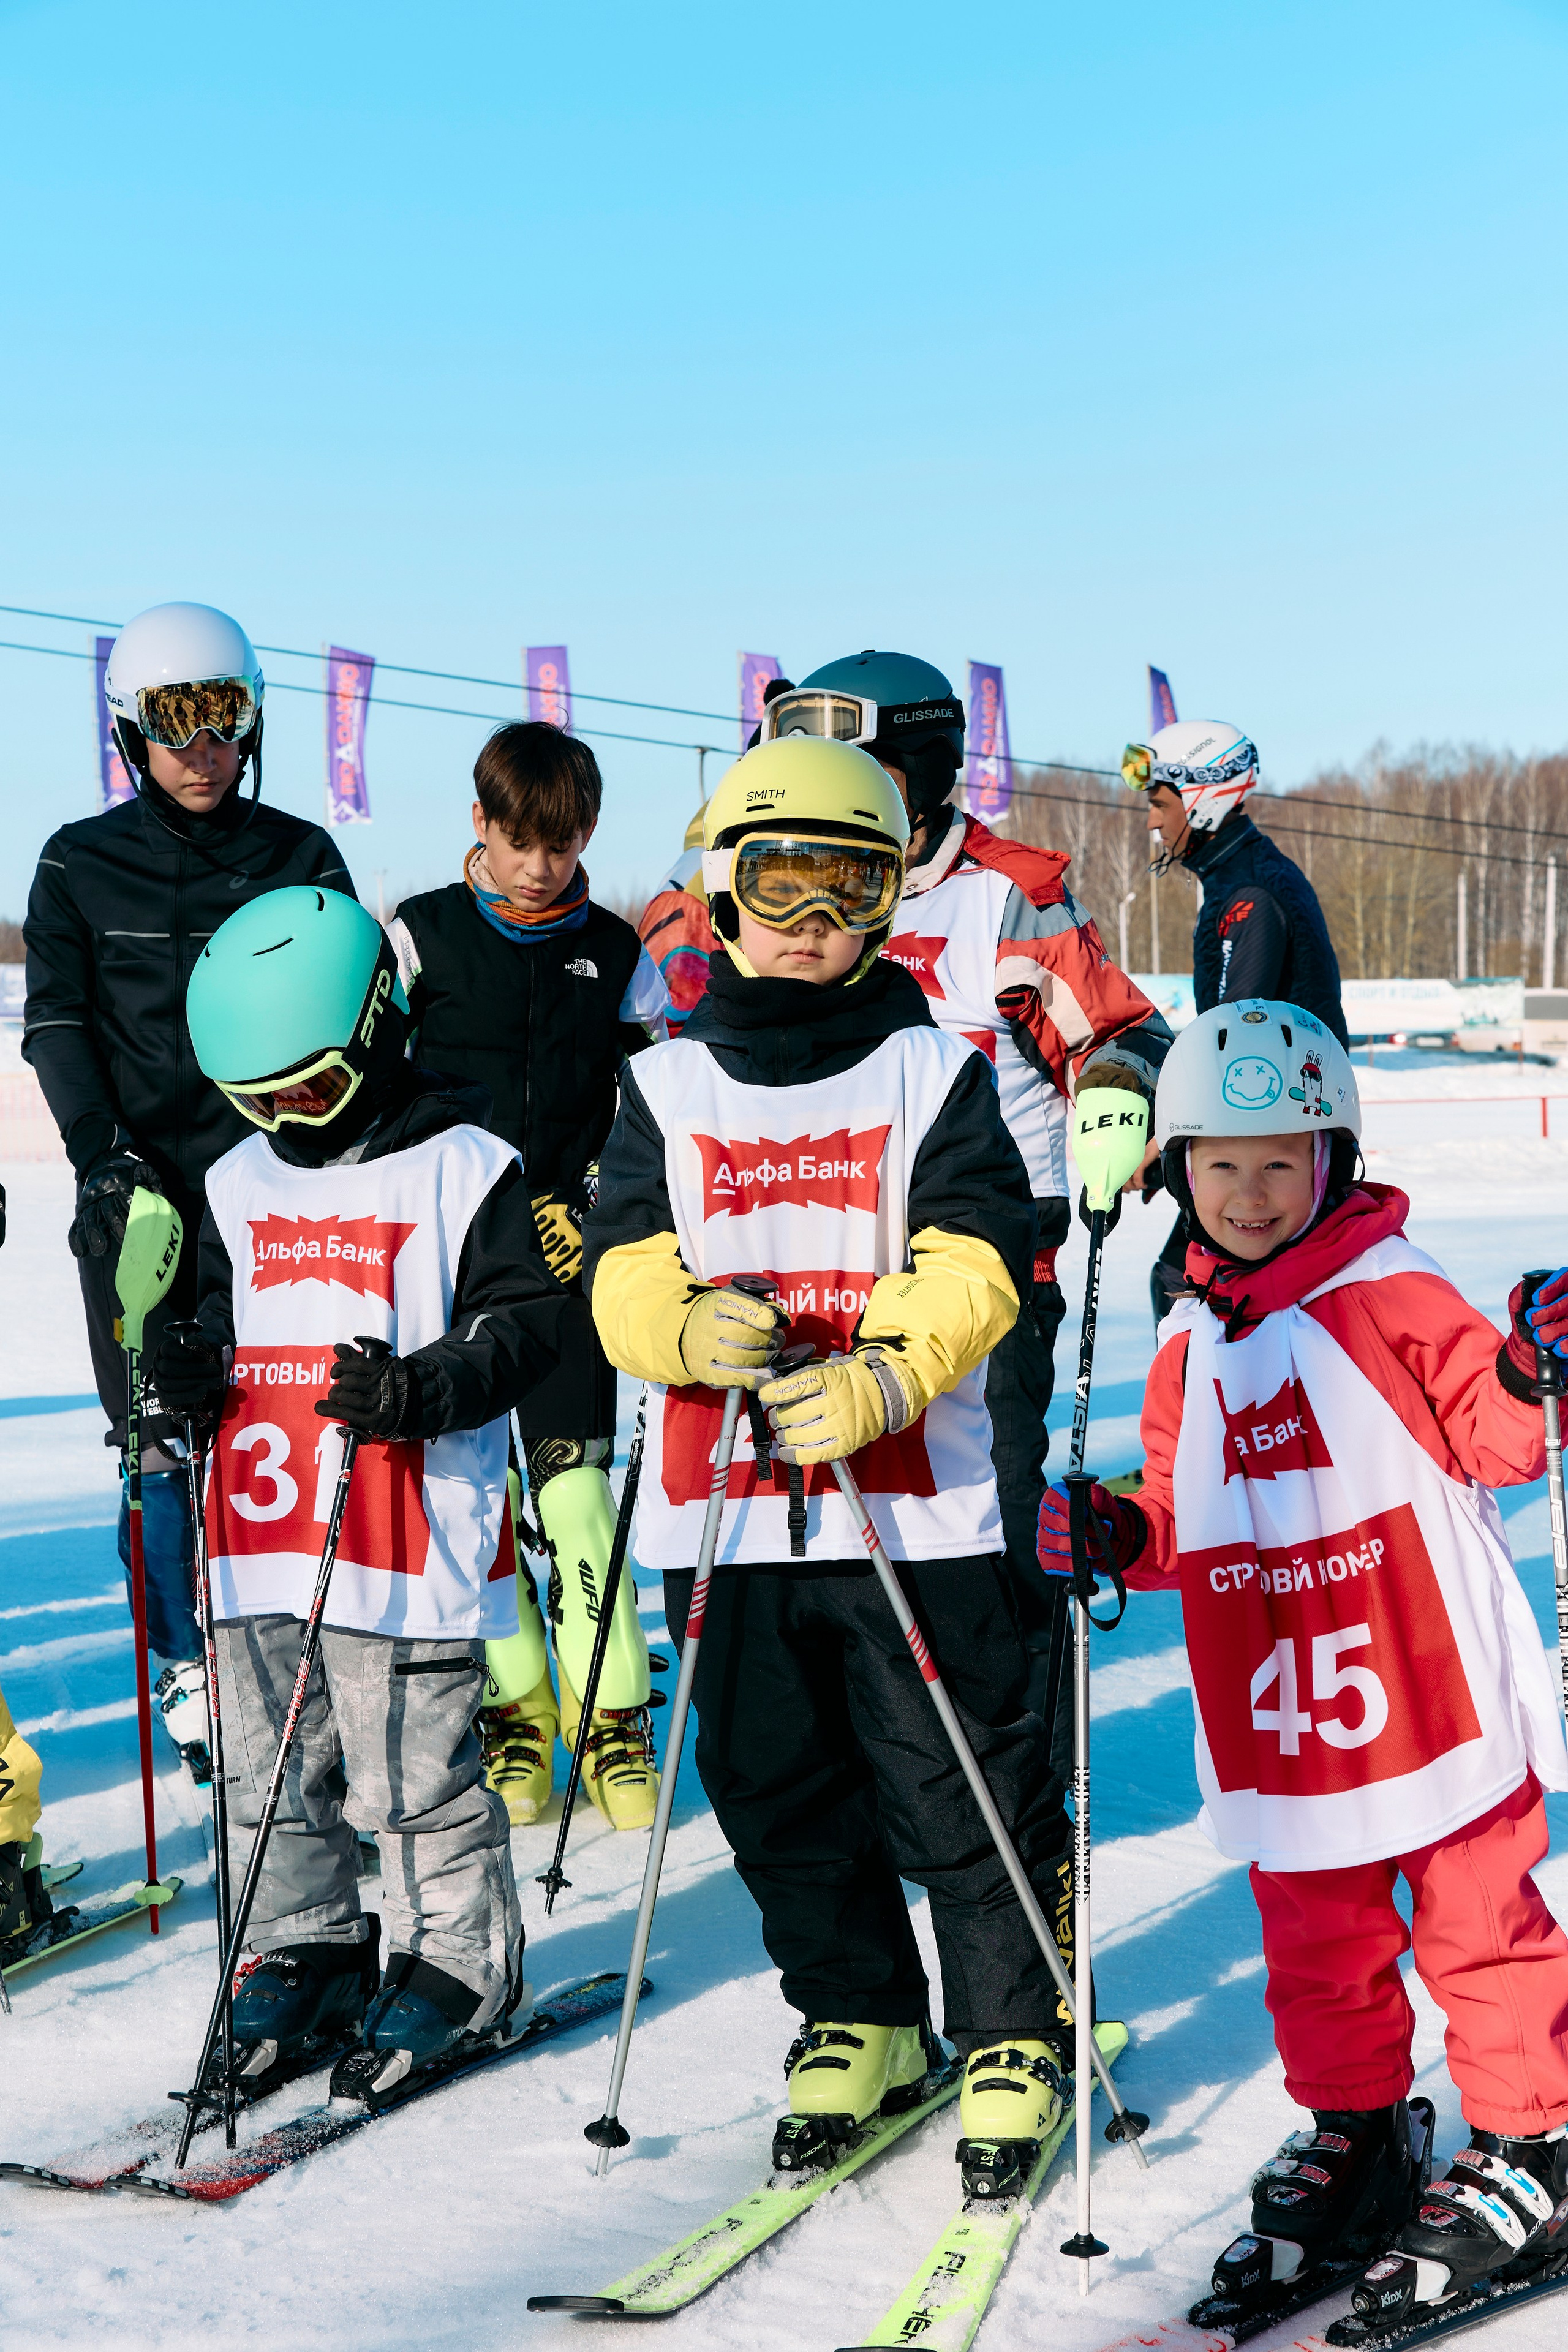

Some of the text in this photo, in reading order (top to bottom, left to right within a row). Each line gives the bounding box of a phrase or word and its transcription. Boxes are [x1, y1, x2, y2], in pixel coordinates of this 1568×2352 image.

[894, 709, 954, 723] GLISSADE
[747, 789, 785, 801] SMITH
[1081, 1112, 1144, 1134] LEKI
[713, 1156, 867, 1188] Альфа Банк
[156, 1223, 180, 1283] LEKI
[257, 1235, 387, 1267] Альфа Банк
[228, 1422, 344, 1523] 31
[579, 1569, 601, 1623] UFO
[282, 1657, 310, 1742] RACE
[1250, 1622, 1389, 1756] 45
[226, 1776, 241, 1784] TURN
[784, 2123, 803, 2139] FS7
[799, 2139, 826, 2162] FISCHER
[980, 2150, 995, 2166] FS7
